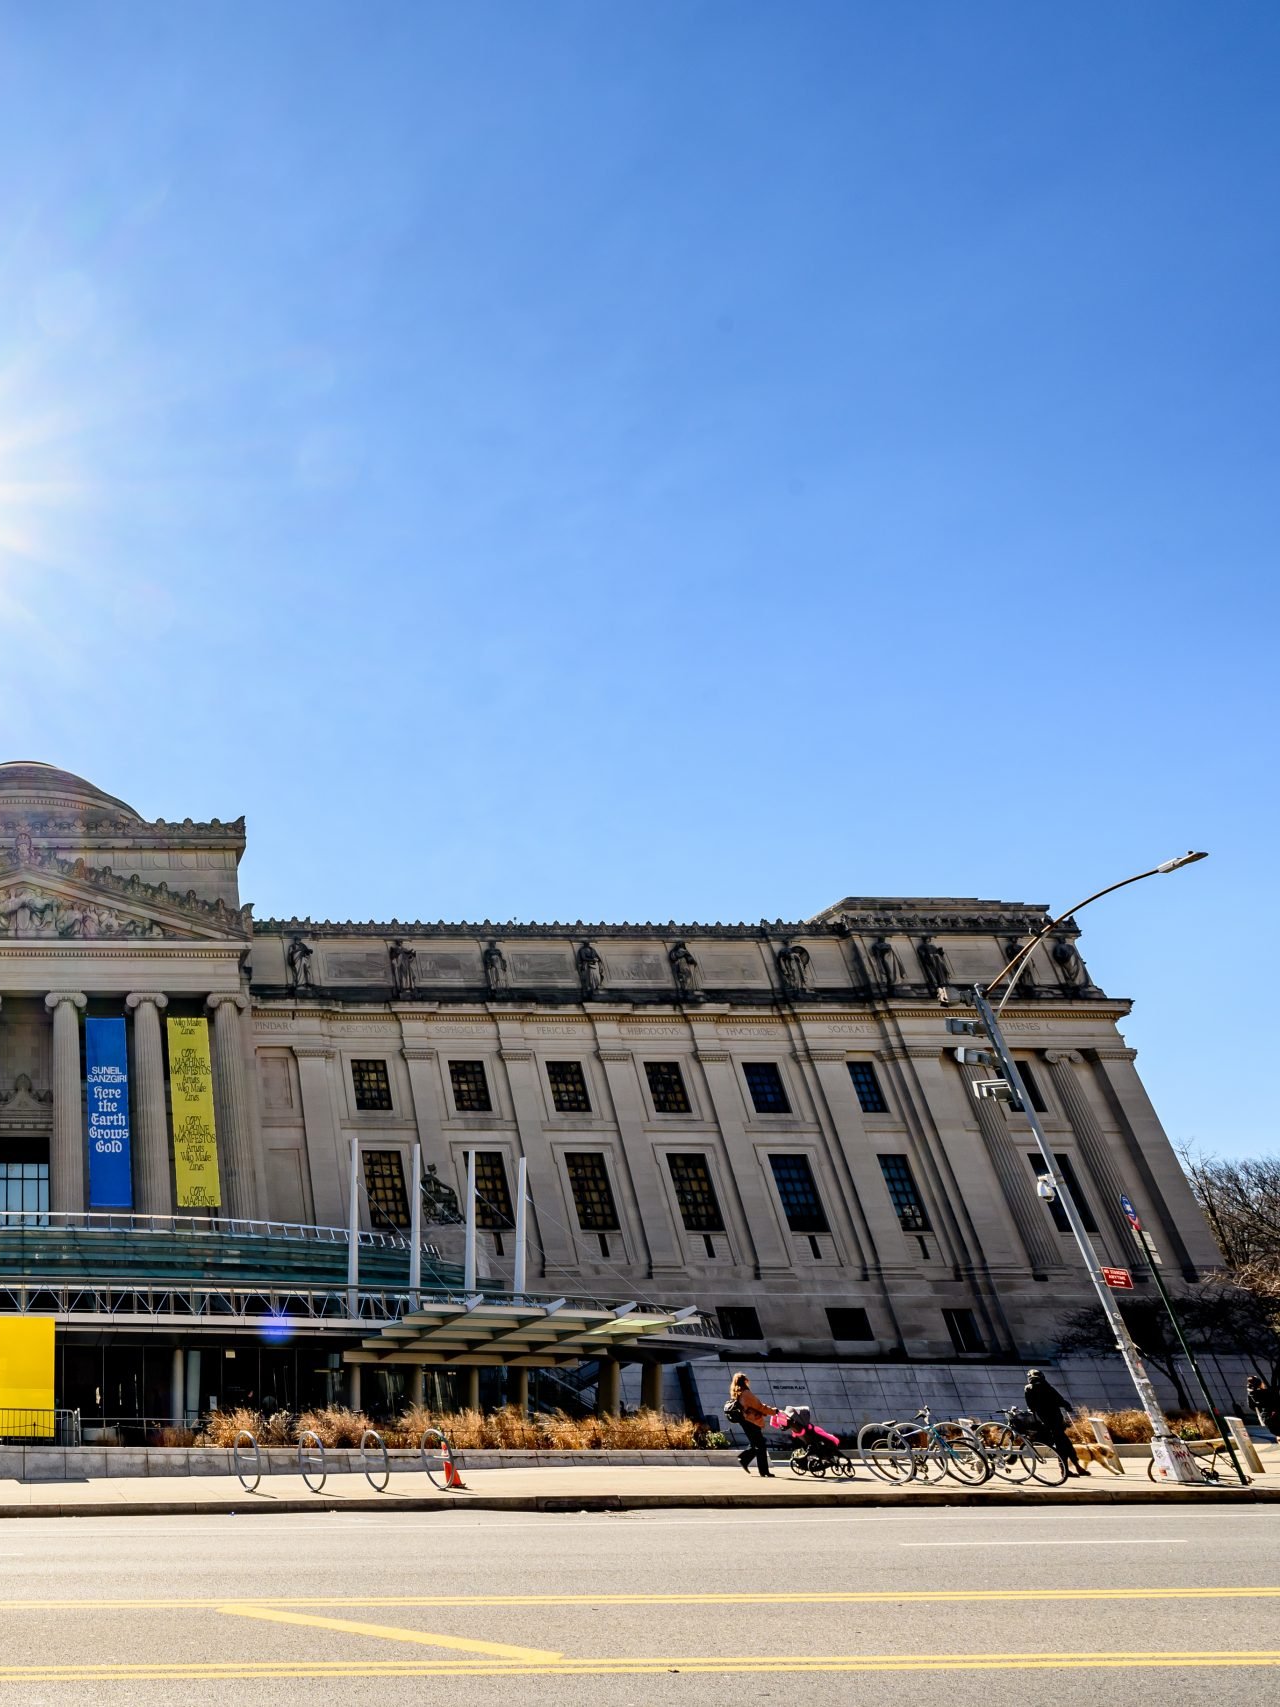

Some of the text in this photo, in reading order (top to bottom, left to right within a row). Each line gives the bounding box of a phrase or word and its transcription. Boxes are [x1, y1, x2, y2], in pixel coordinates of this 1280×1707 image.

[536, 1026, 577, 1035] PERICLES
[827, 1025, 877, 1034] SOCRATES
[175, 1057, 206, 1067] MACHINE
[91, 1066, 123, 1075] SUNEIL
[87, 1074, 127, 1083] SANZGIRI
[93, 1086, 122, 1099] Here
[98, 1099, 118, 1112] the
[91, 1113, 126, 1126] Earth
[89, 1126, 129, 1139] Grows
[178, 1125, 210, 1135] MACHINE
[95, 1140, 123, 1153] Gold
